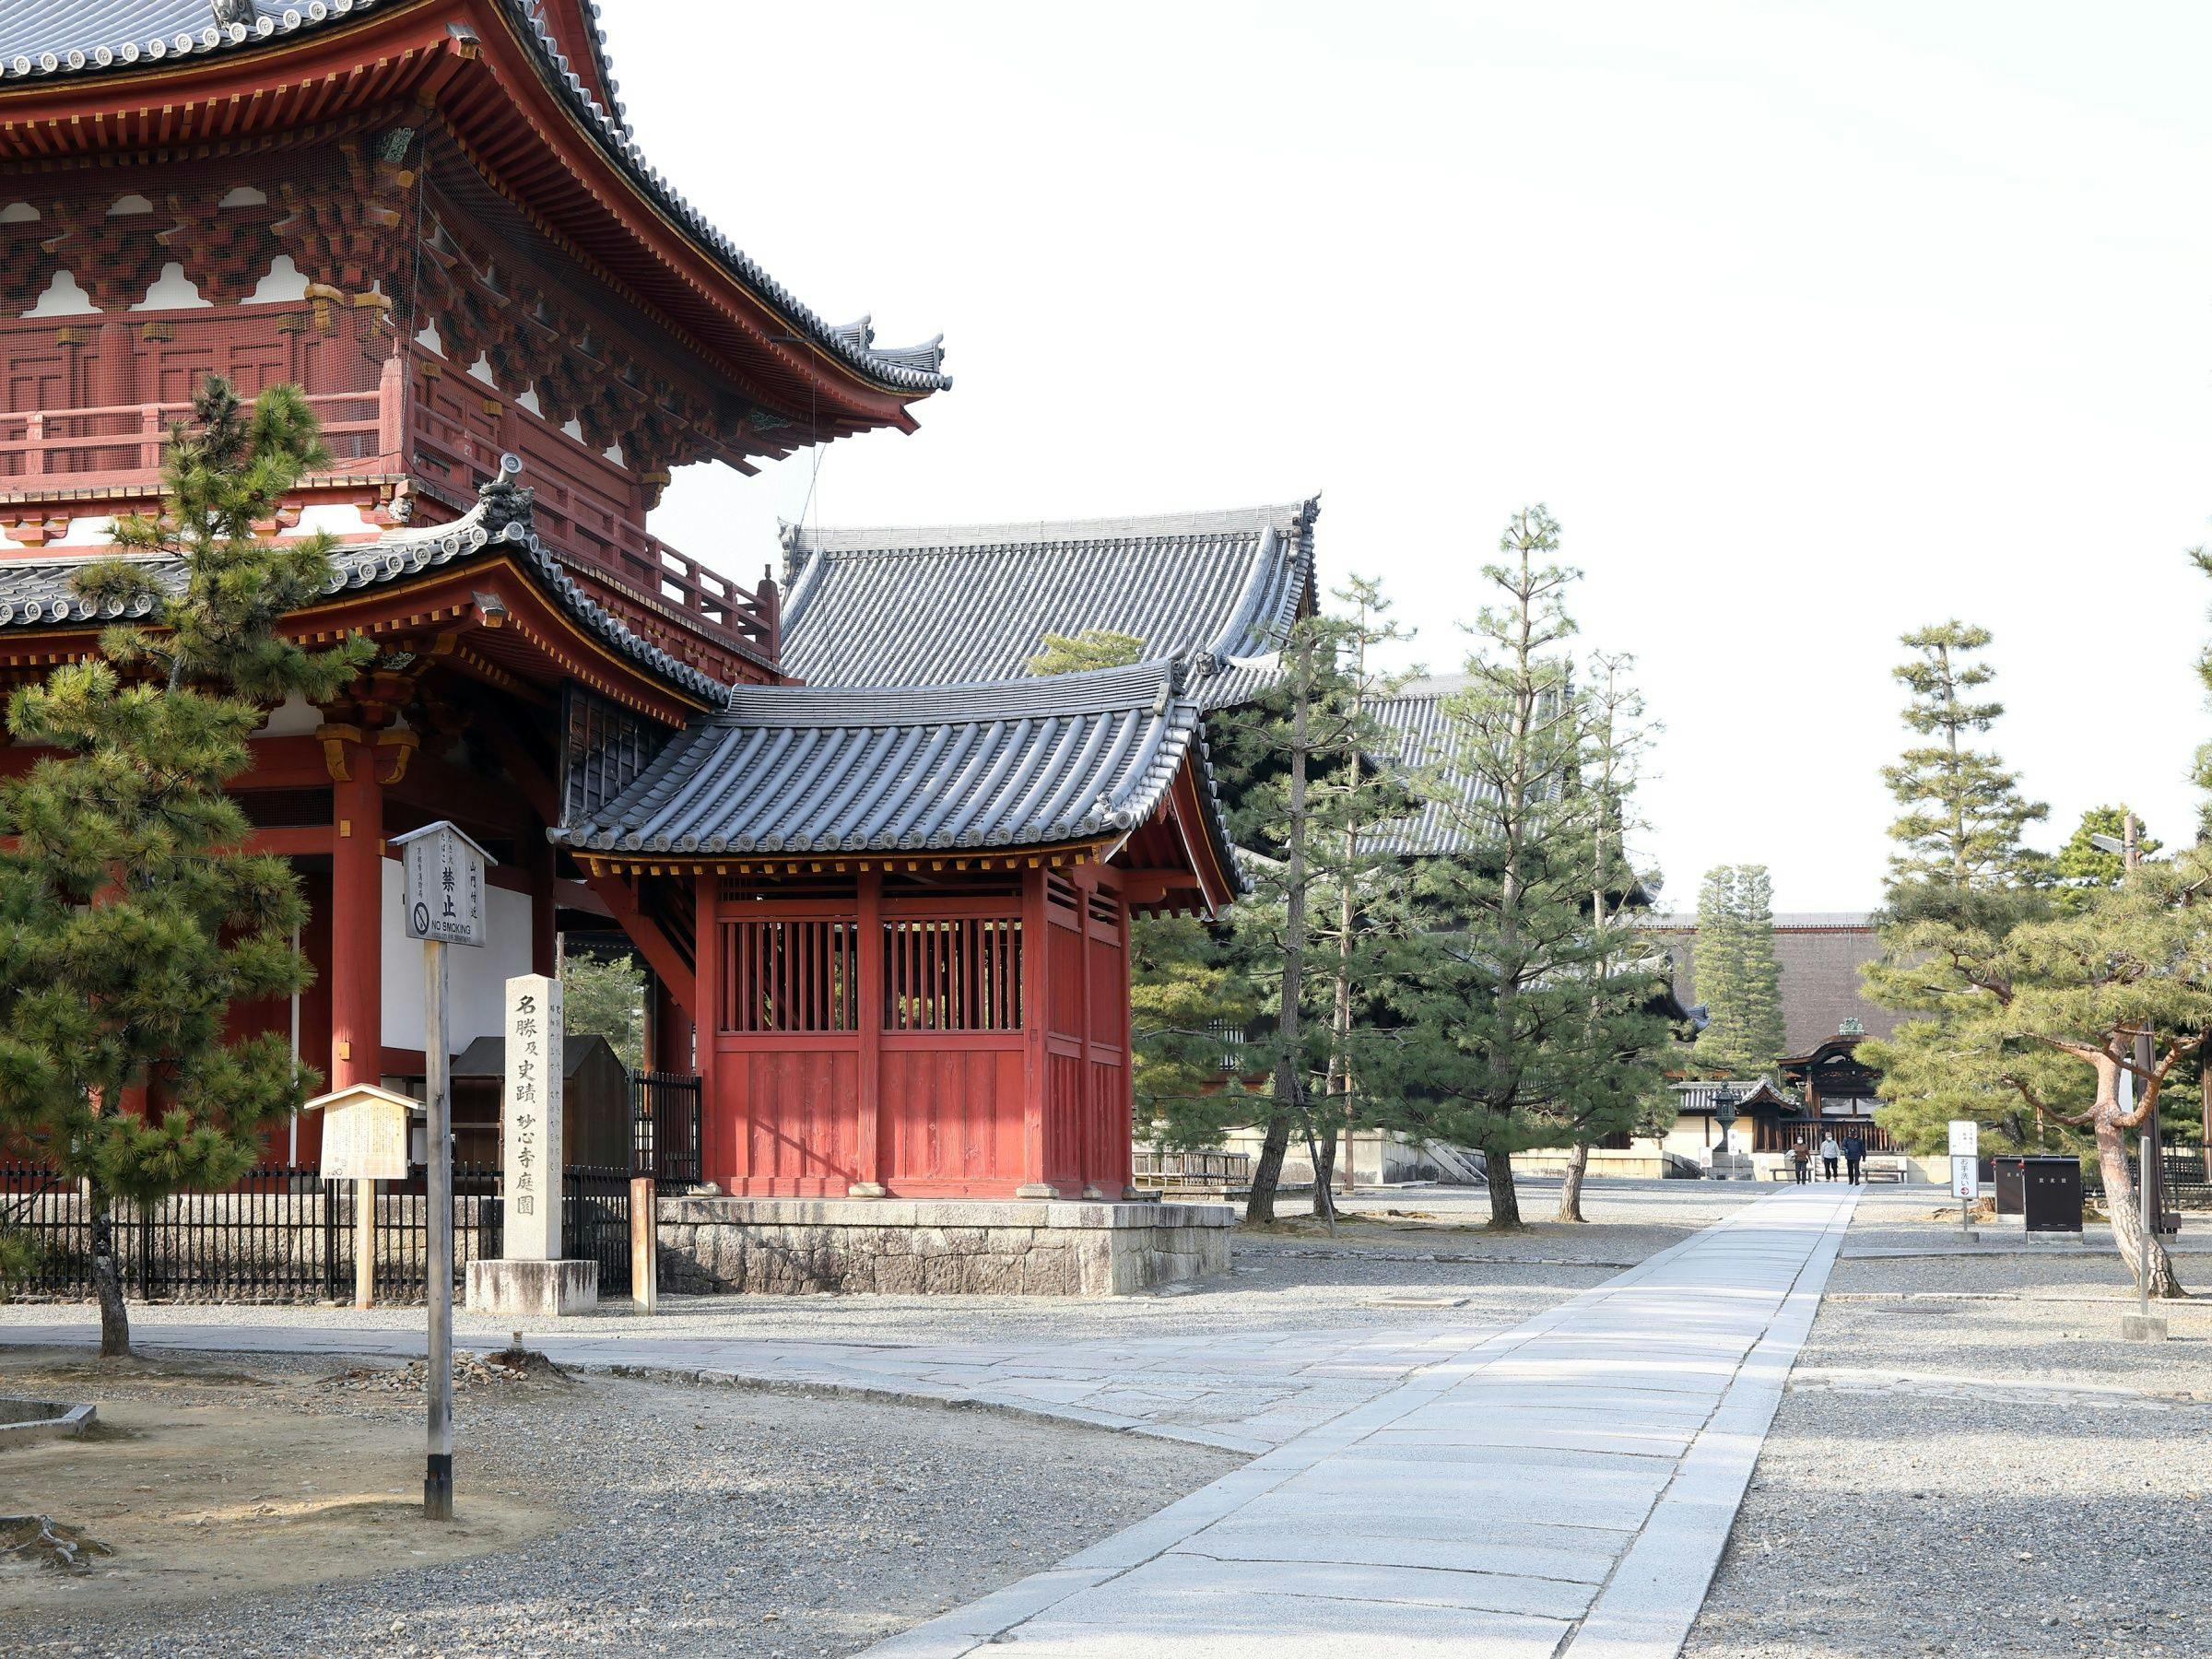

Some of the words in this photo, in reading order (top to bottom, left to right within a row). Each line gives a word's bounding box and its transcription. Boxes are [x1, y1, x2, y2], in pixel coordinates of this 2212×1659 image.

[442, 866, 456, 918] 禁止
[470, 861, 478, 919] 山門付近
[431, 920, 441, 931] NO
[442, 922, 471, 935] SMOKING
[1960, 1159, 1970, 1186] お手洗い
